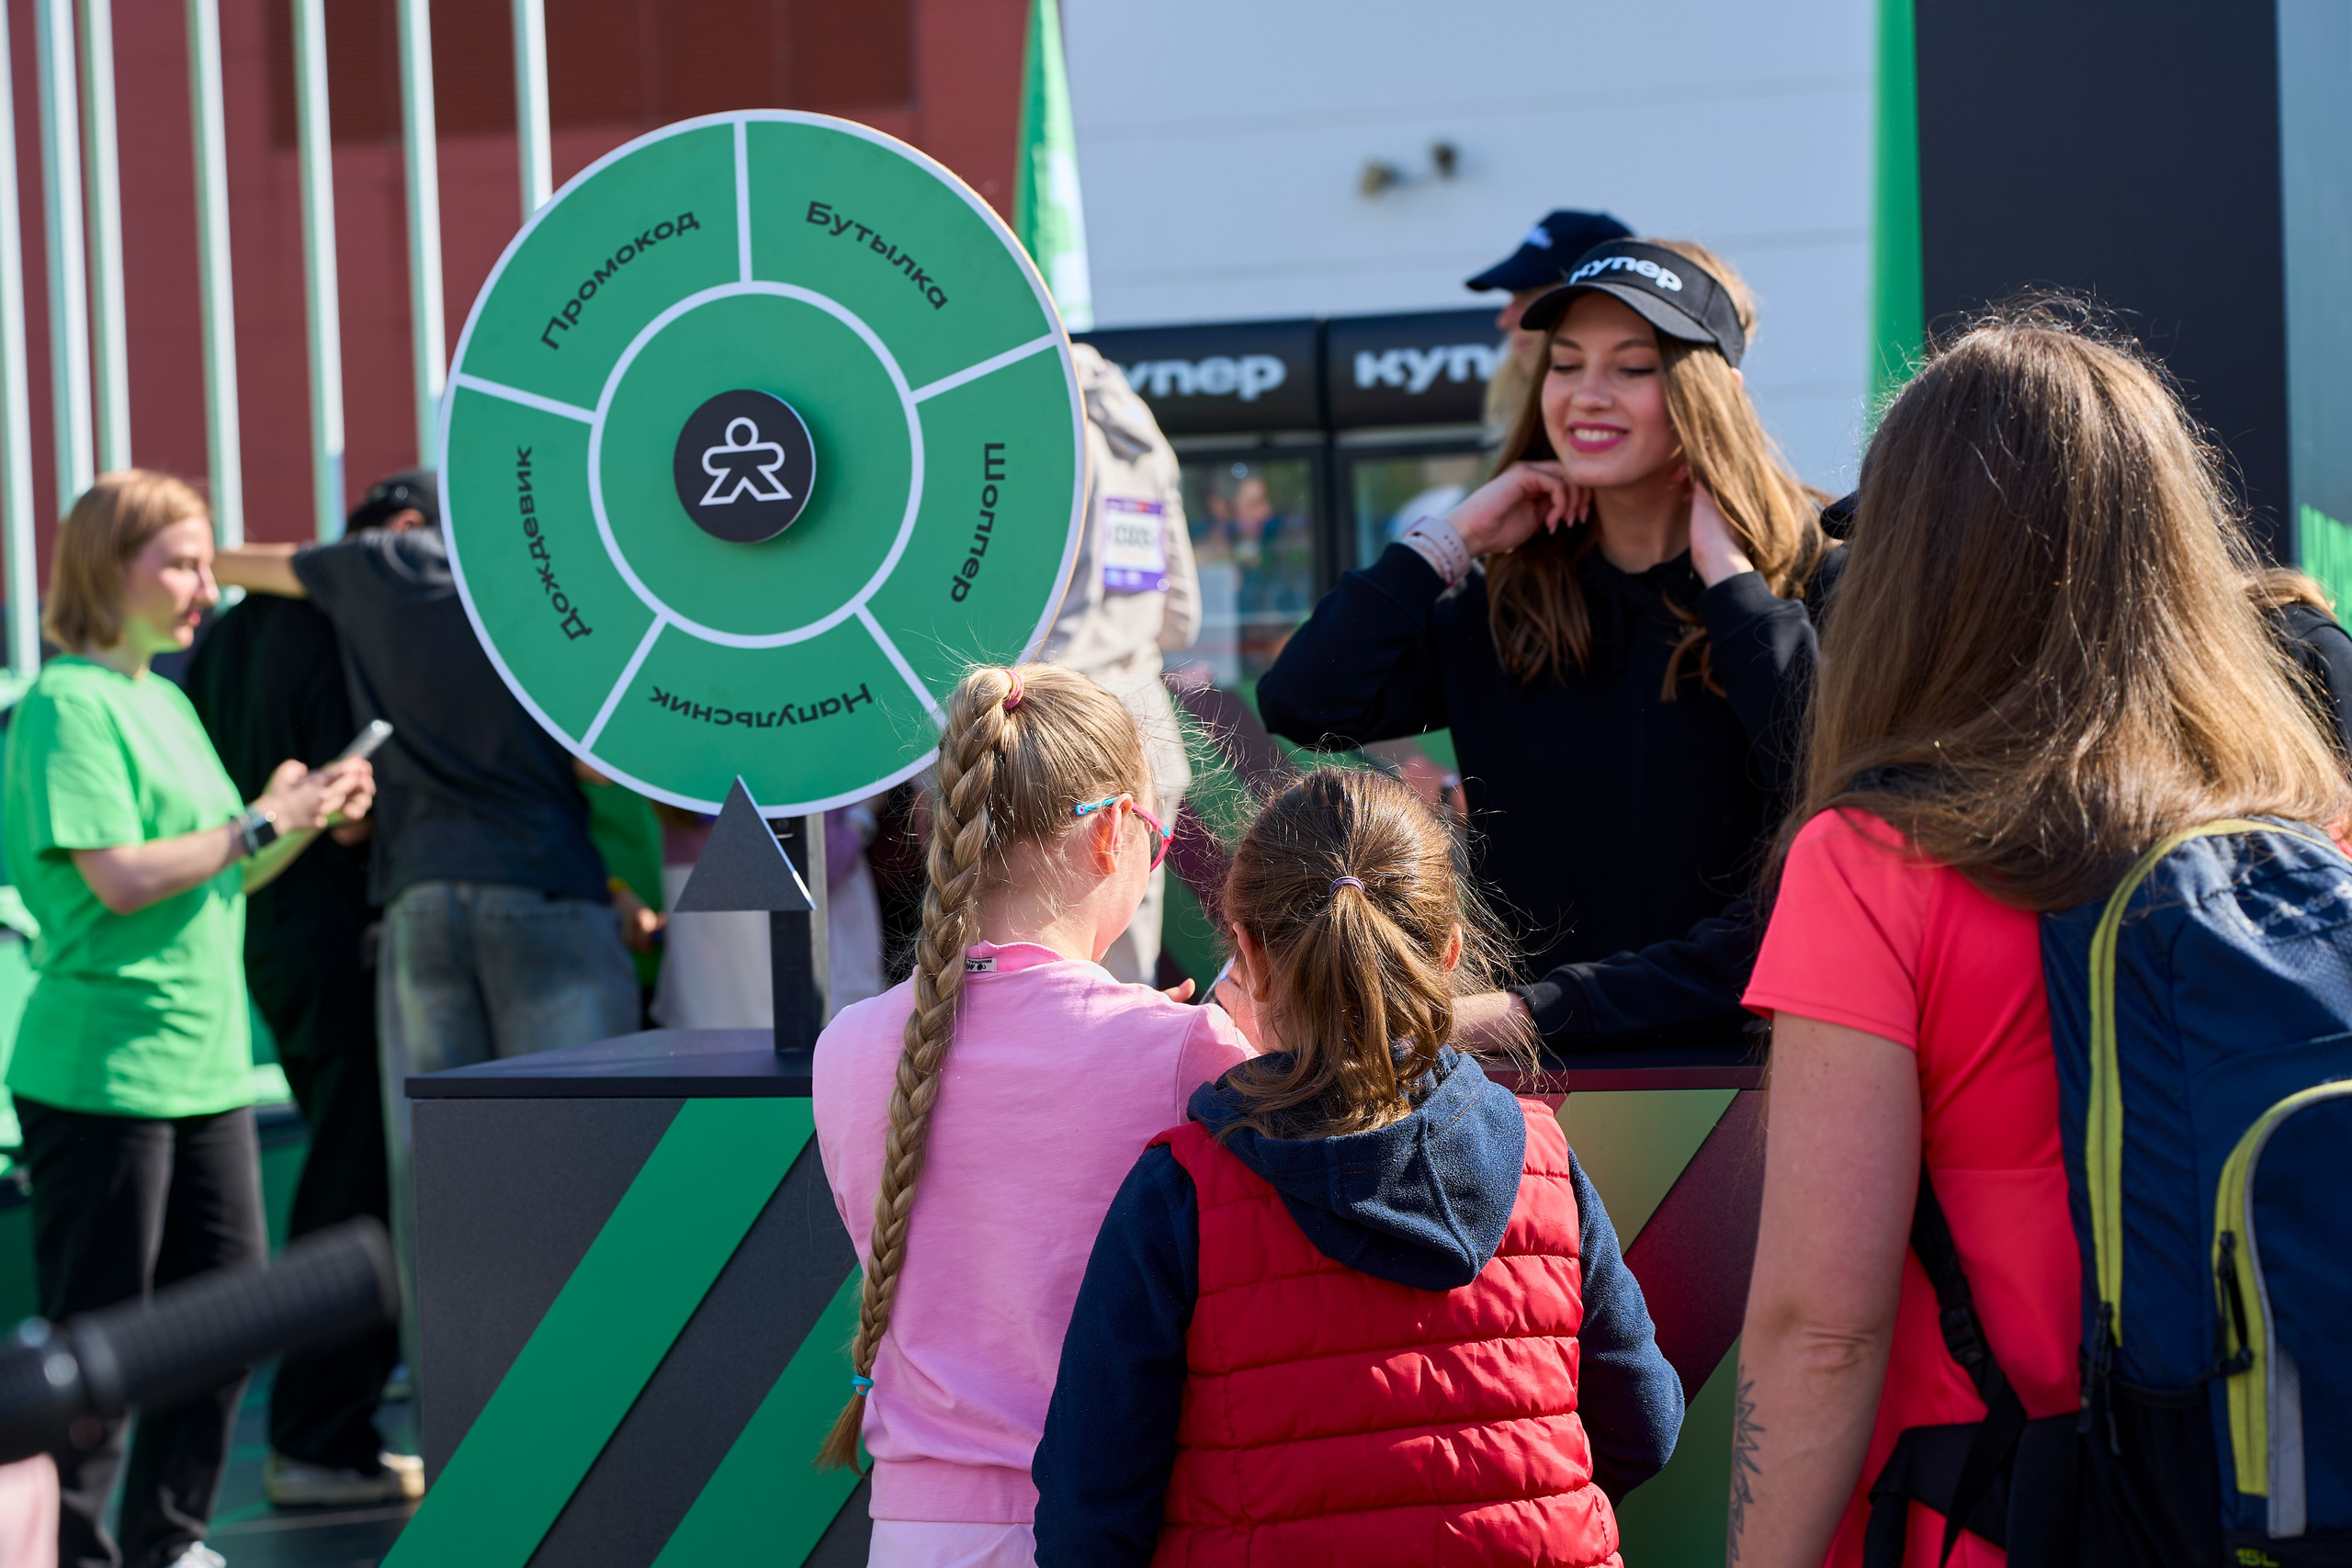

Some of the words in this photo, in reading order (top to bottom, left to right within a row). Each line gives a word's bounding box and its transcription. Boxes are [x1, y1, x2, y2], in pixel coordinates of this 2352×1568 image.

[540, 211, 701, 350] Промокод
[806, 200, 948, 310] Бутылка
[1568, 256, 1683, 292] купер
[1114, 354, 1287, 401] упер
[1353, 341, 1510, 395] куп
[516, 446, 594, 641] Дождевик
[950, 442, 1006, 604] Шоппер
[648, 682, 874, 728] Напульсник
